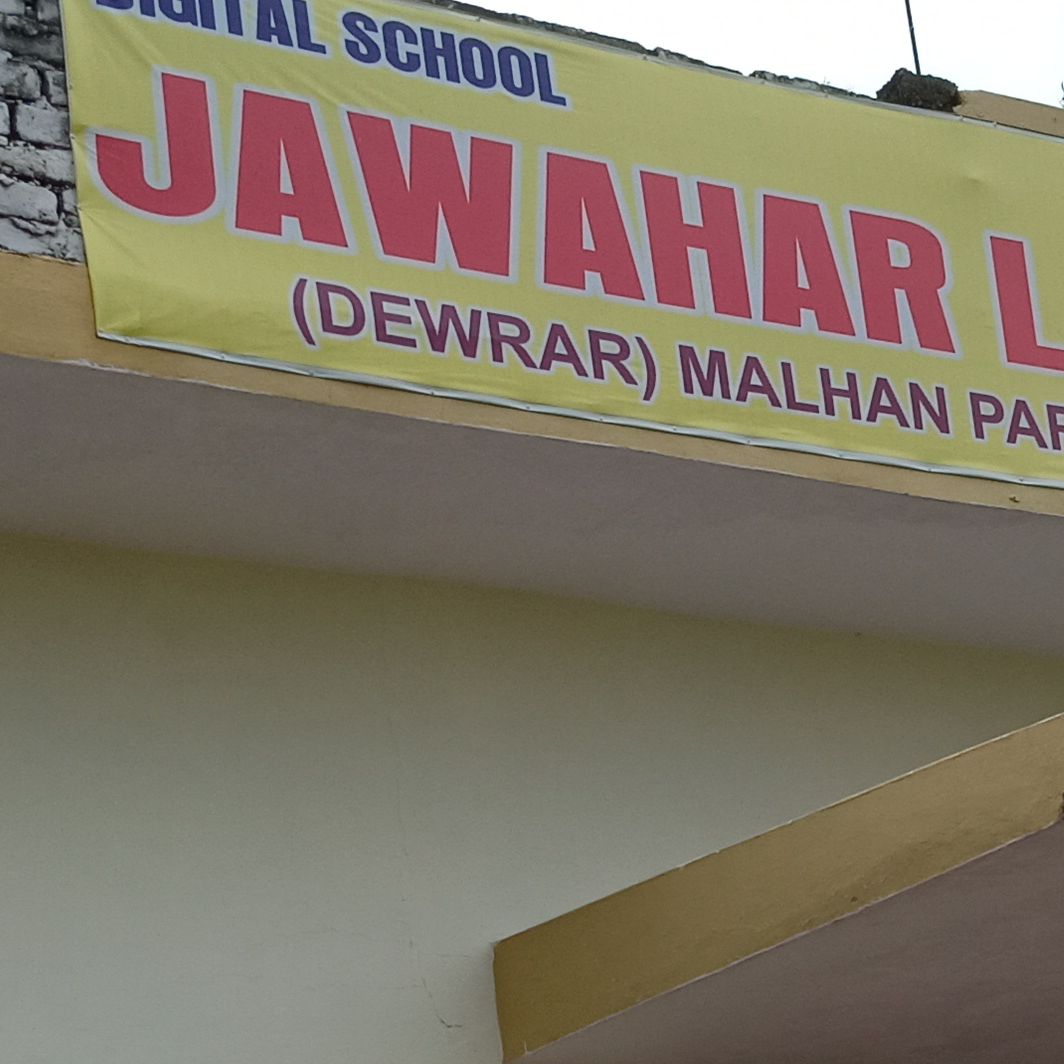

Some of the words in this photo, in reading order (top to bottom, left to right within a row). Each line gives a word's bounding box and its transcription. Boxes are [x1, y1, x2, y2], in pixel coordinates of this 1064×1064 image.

[95, 0, 328, 55] GITAL
[341, 11, 567, 107] SCHOOL
[95, 72, 956, 354] JAWAHAR
[292, 278, 657, 402] (DEWRAR)
[678, 344, 951, 435] MALHAN
